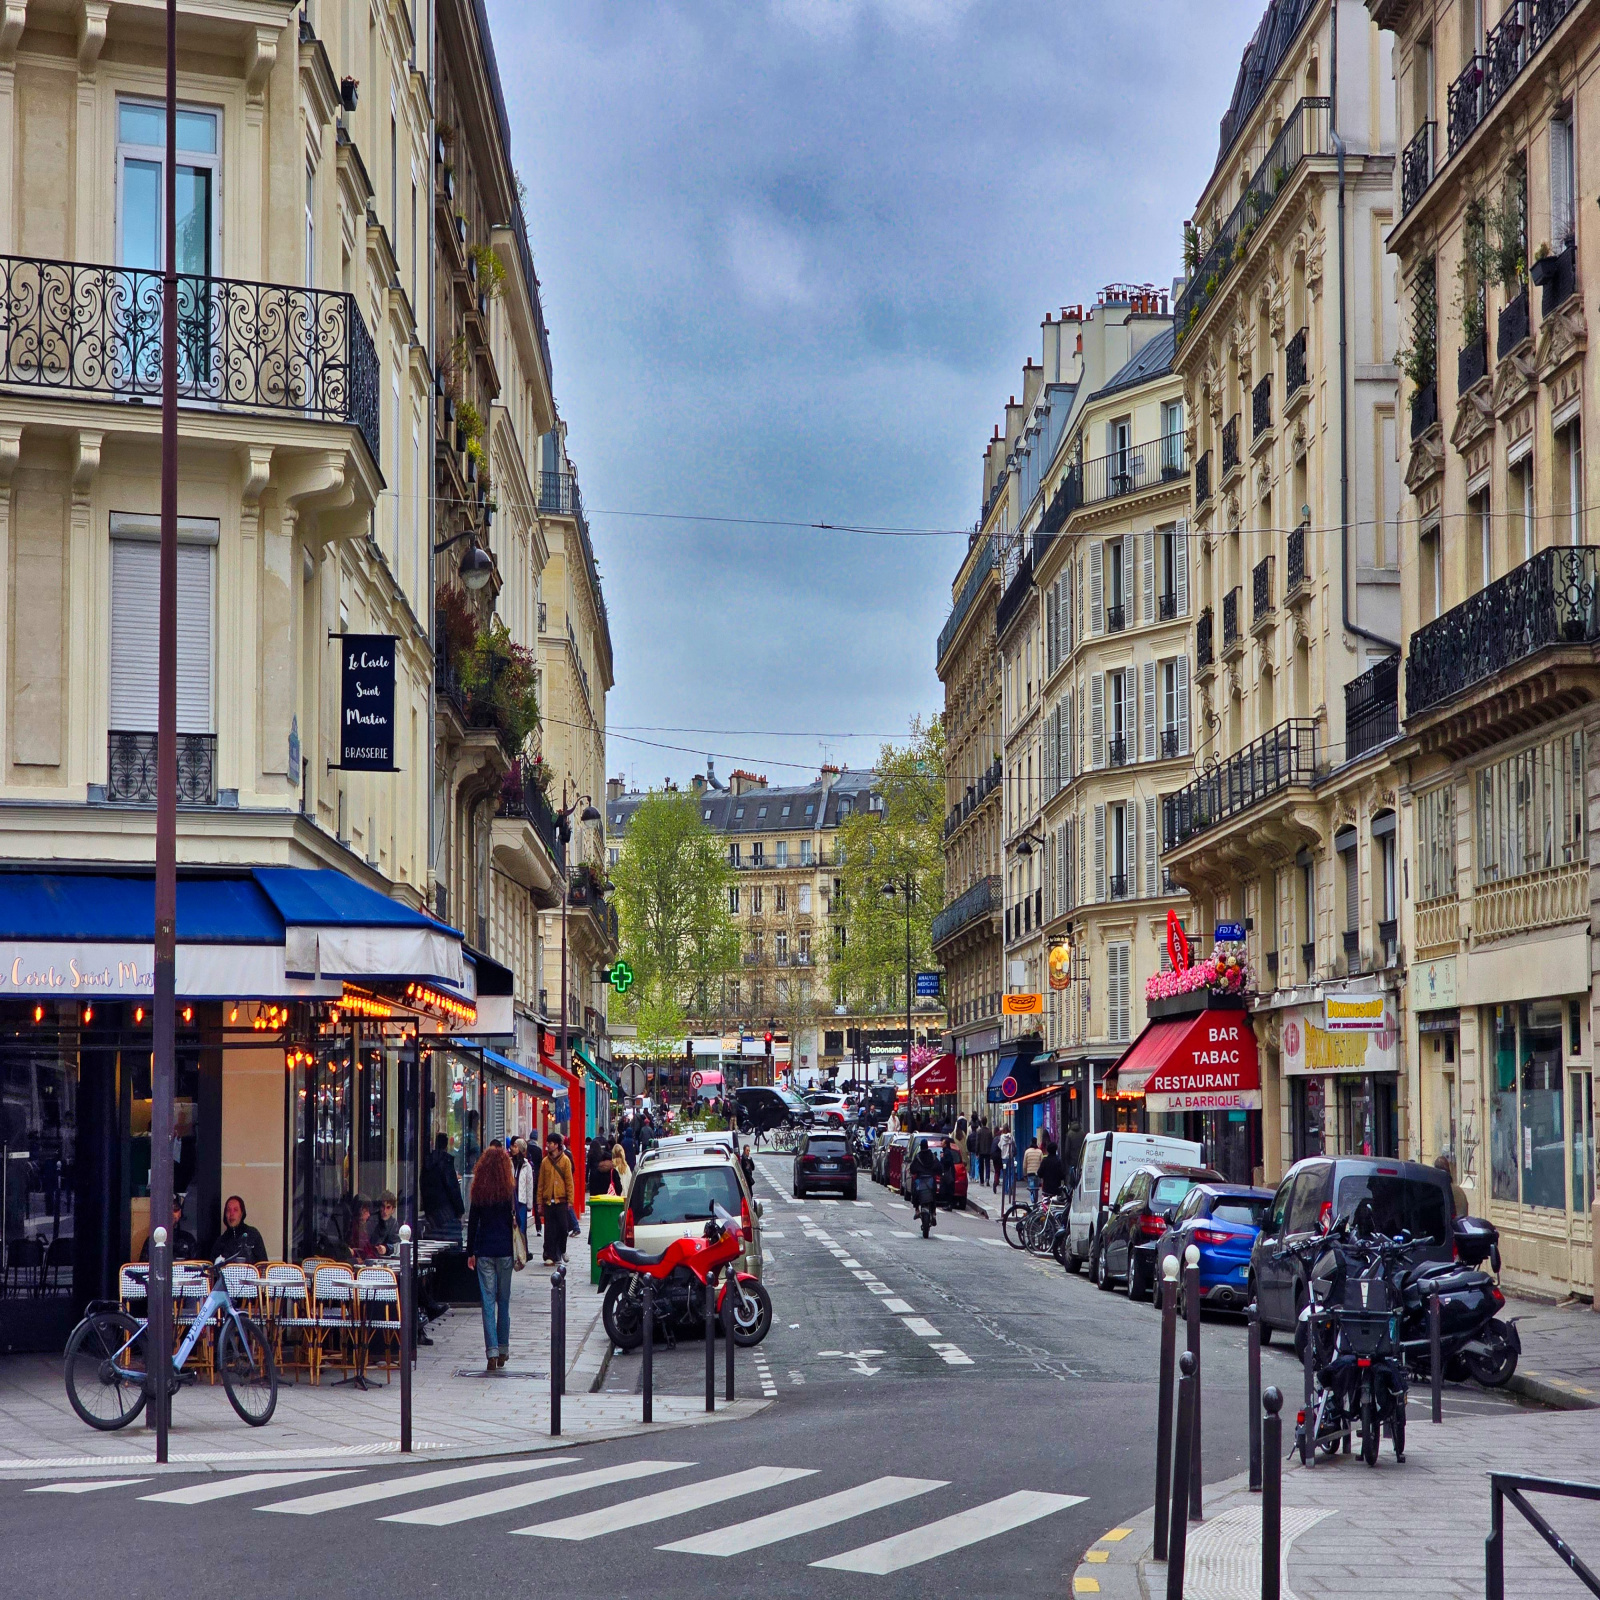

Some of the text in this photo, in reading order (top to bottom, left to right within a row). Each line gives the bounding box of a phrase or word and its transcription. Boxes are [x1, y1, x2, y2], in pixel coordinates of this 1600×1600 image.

[348, 652, 389, 670] Le Cercle
[356, 681, 380, 698] Saint
[346, 708, 387, 725] Martin
[345, 746, 389, 759] BRASSERIE
[1219, 926, 1232, 934] FDJ
[11, 956, 66, 987] Cercle
[69, 957, 113, 988] Saint
[1327, 998, 1383, 1018] BOXINGSHOP
[1208, 1027, 1239, 1042] BAR
[869, 1046, 903, 1054] cDonald's
[1192, 1050, 1240, 1065] TABAC
[1154, 1073, 1240, 1090] RESTAURANT
[1168, 1095, 1240, 1108] LA BARRIQUE
[191, 1306, 208, 1332] Dance
